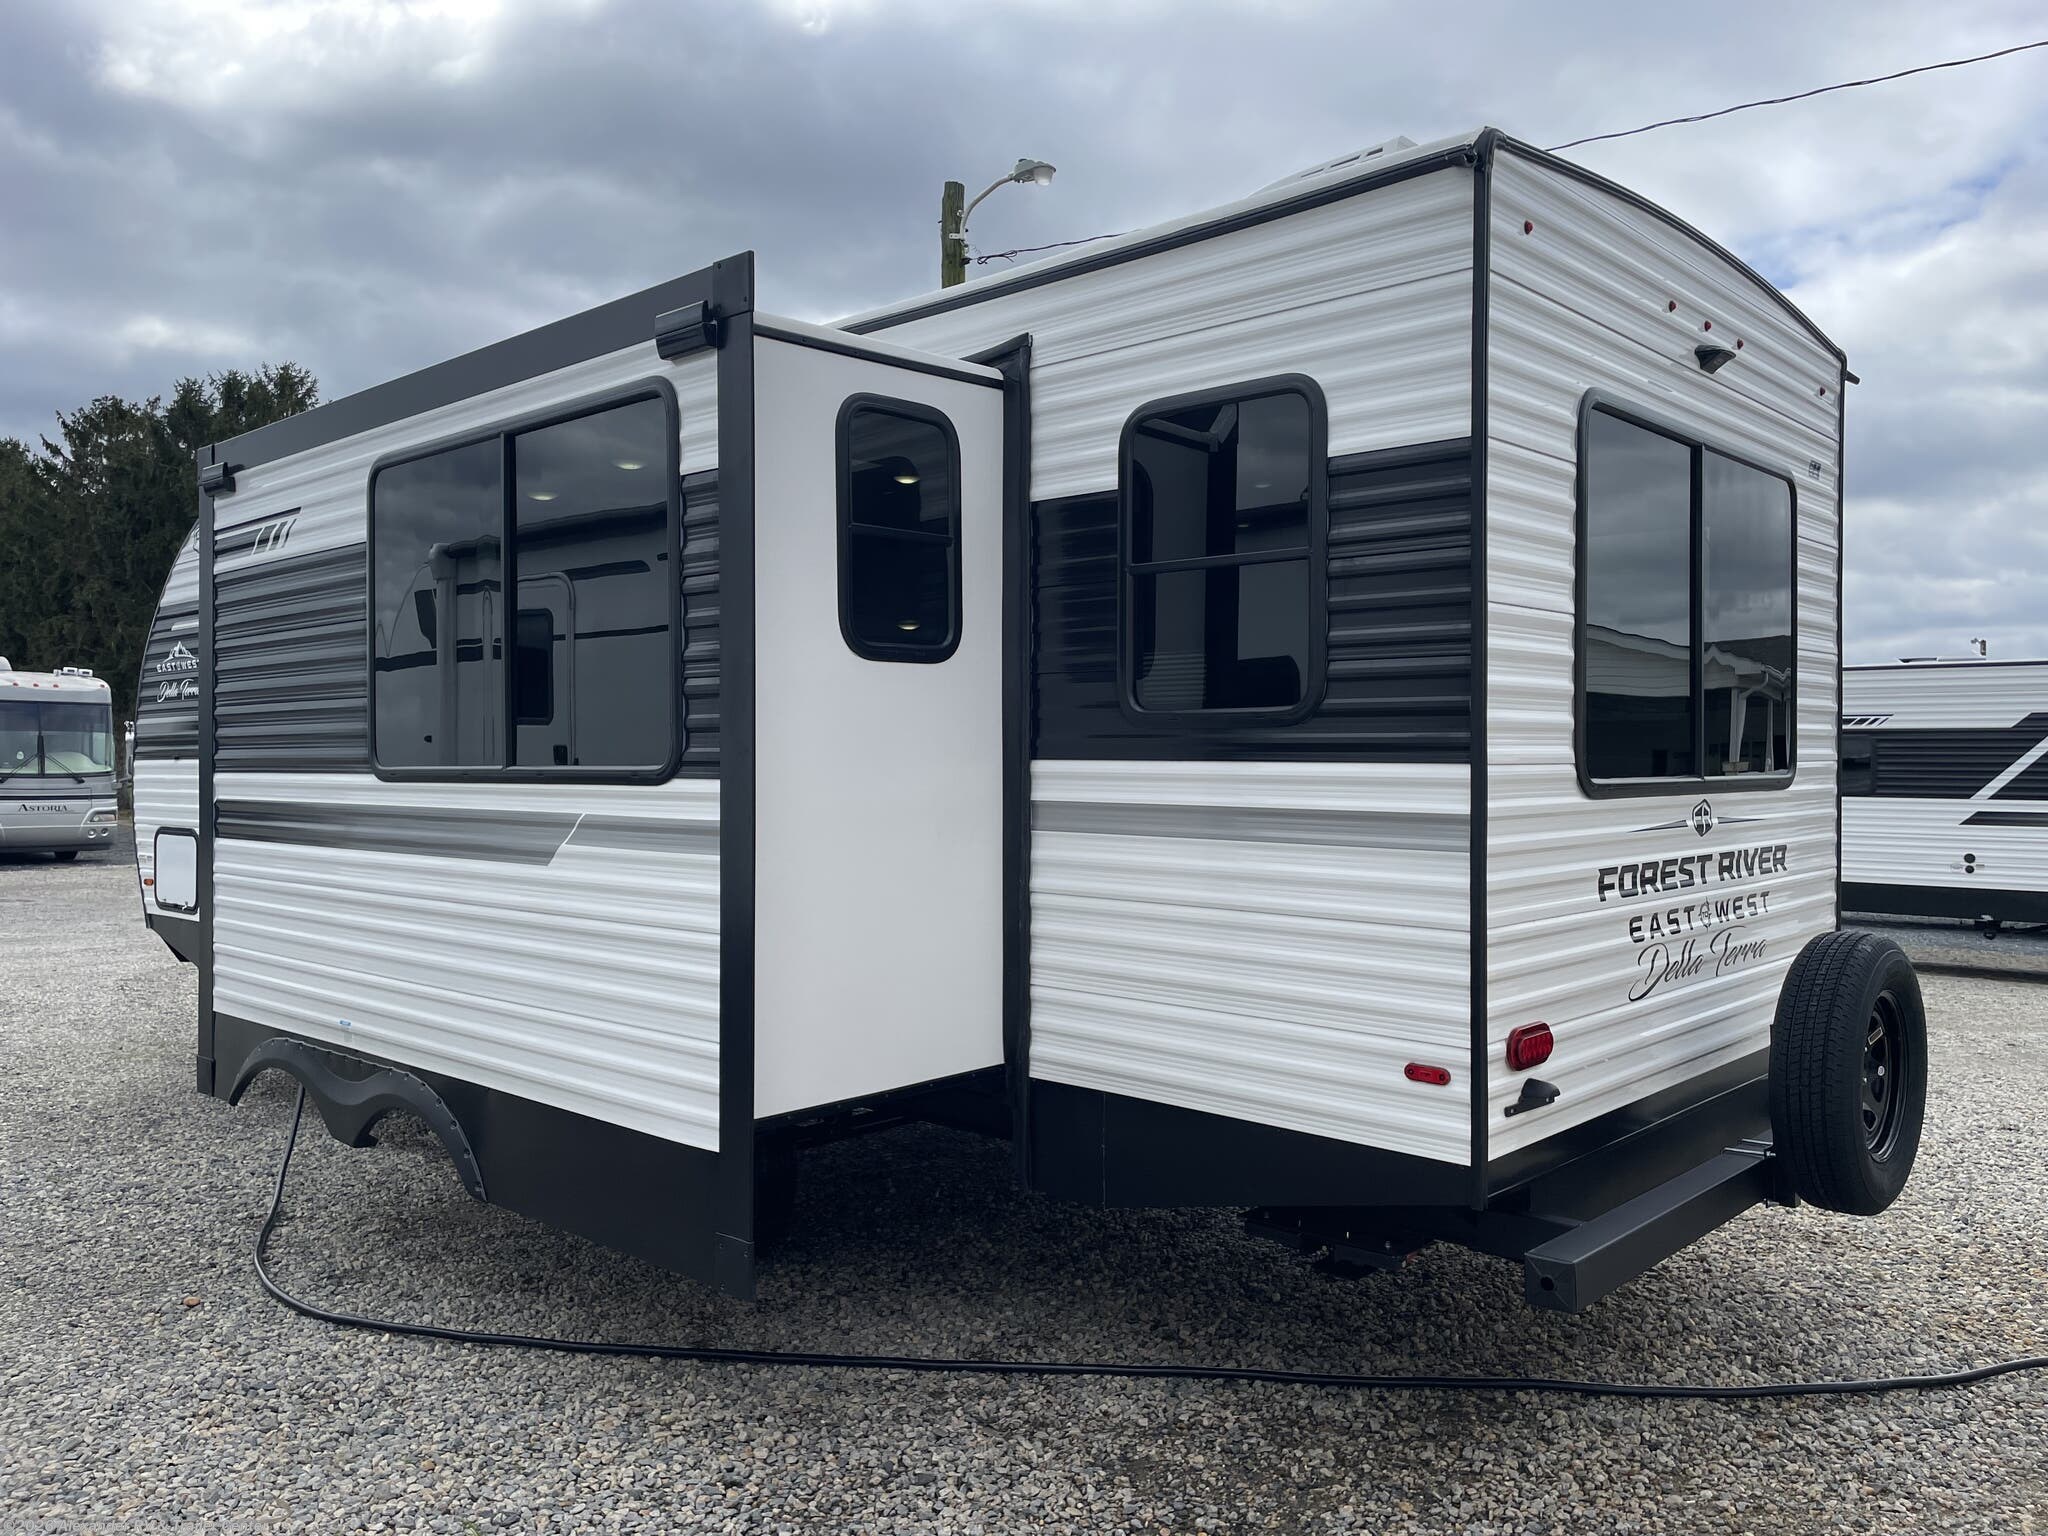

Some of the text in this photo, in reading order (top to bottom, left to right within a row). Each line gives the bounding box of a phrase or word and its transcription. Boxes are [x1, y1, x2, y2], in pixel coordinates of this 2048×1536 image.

[156, 662, 176, 673] EAST
[1597, 844, 1788, 902] FOREST RIVER
[1629, 905, 1696, 943] EAST
[1714, 890, 1770, 923] WEST
[1628, 925, 1767, 1002] Della Terra
